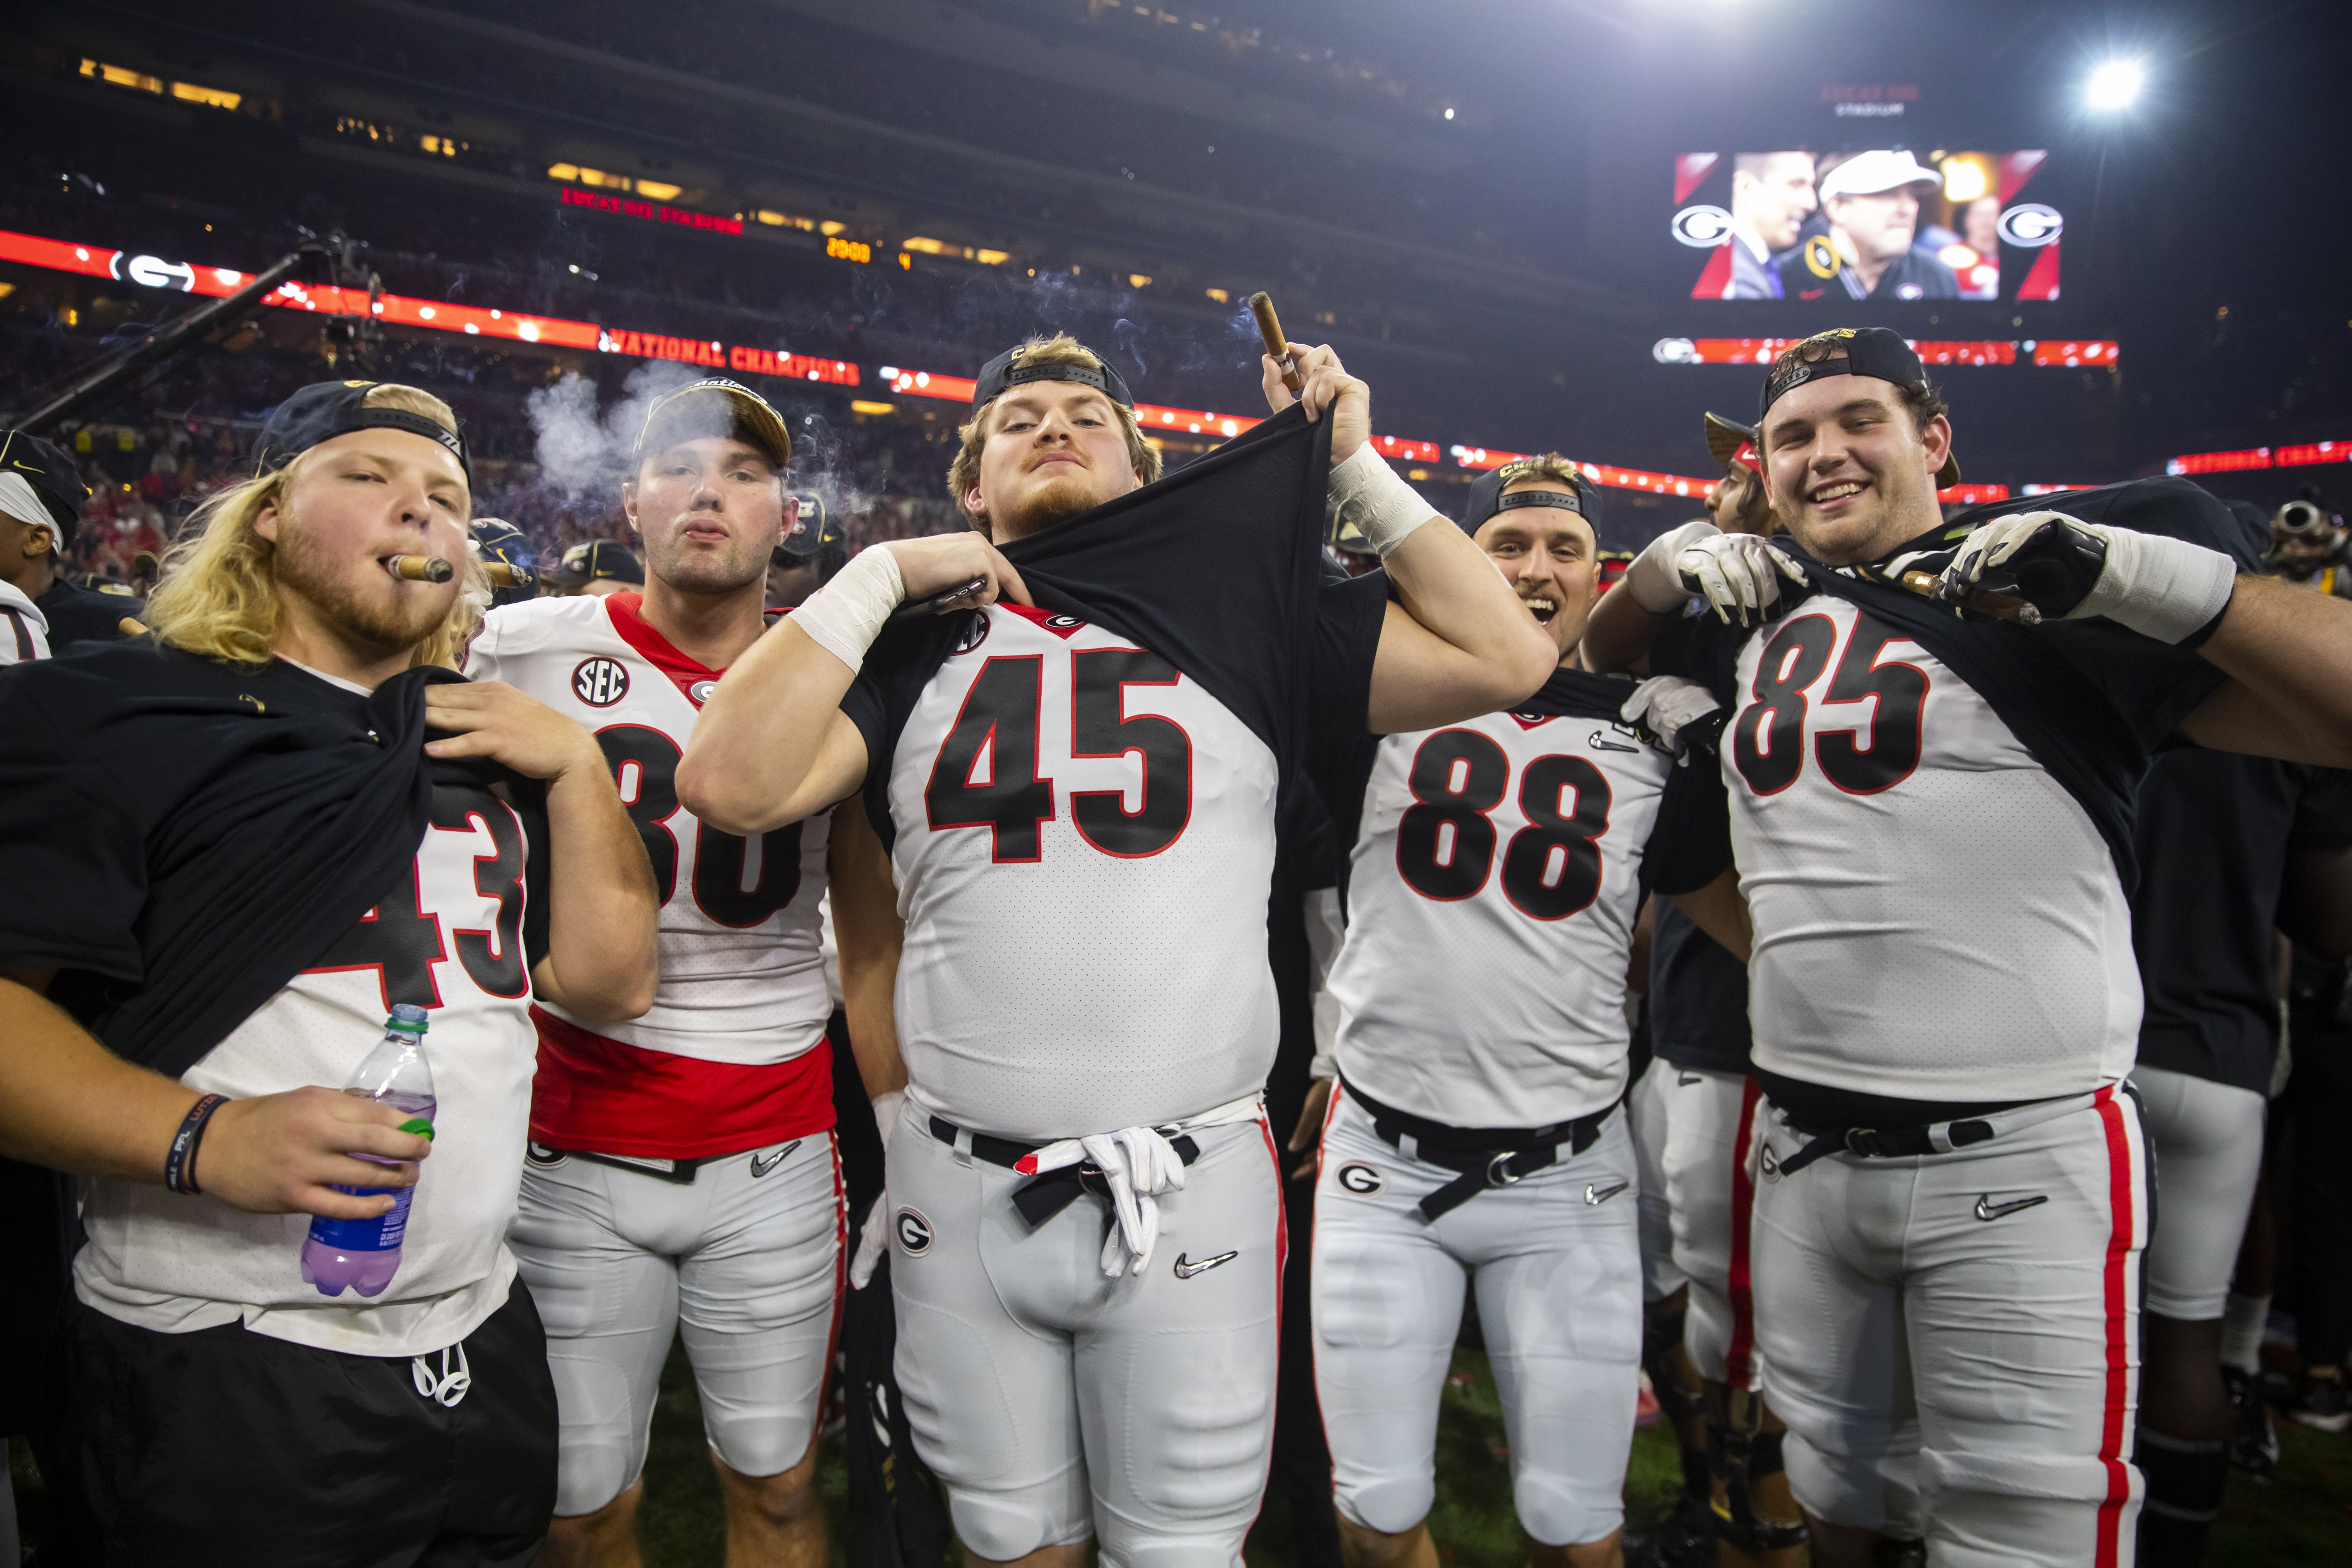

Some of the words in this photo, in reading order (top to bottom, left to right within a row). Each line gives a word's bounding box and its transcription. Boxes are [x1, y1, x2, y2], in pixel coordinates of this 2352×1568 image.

[562, 188, 619, 213] LUCAS
[624, 200, 653, 219] OIL
[660, 207, 742, 235] STADIUM
[609, 328, 726, 367] NATIONAL
[731, 346, 860, 386] CHAMPIONS
[577, 660, 625, 703] SEC
[1733, 609, 1930, 796] 85
[924, 646, 1192, 864] 45
[1396, 727, 1612, 921] 88
[174, 1130, 190, 1152] PFL
